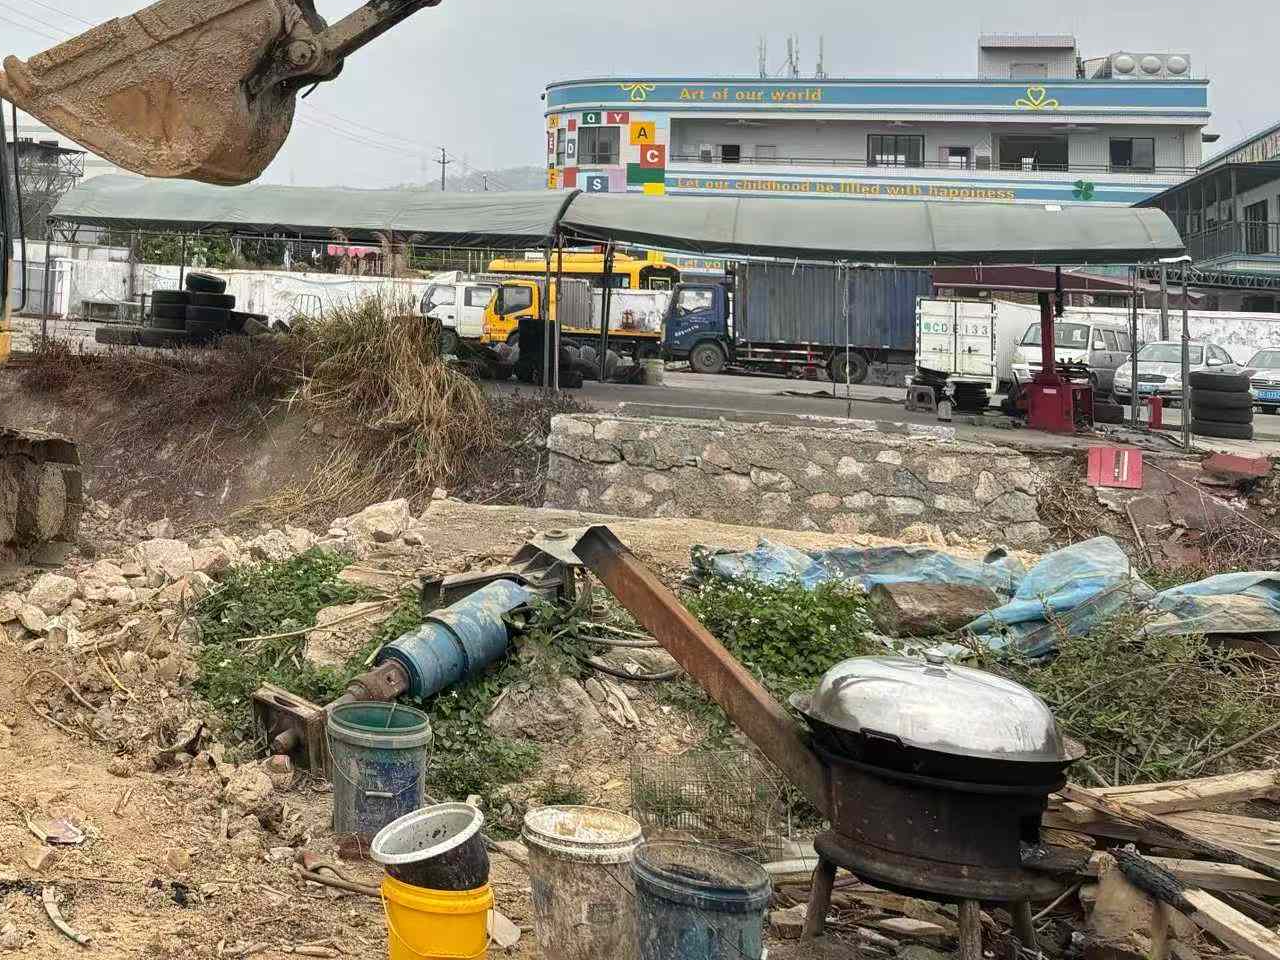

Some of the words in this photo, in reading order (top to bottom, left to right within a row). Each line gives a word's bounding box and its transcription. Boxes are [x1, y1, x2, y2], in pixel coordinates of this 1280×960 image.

[680, 88, 704, 100] Art
[713, 88, 728, 100] of
[735, 90, 763, 100] our
[771, 88, 822, 101] world
[637, 127, 648, 139] A
[646, 149, 660, 162] C
[592, 179, 602, 190] S
[705, 179, 730, 189] our
[735, 179, 811, 192] childhood
[816, 182, 834, 192] be
[840, 181, 881, 194] filled
[886, 184, 921, 196] with
[928, 185, 1016, 200] happiness
